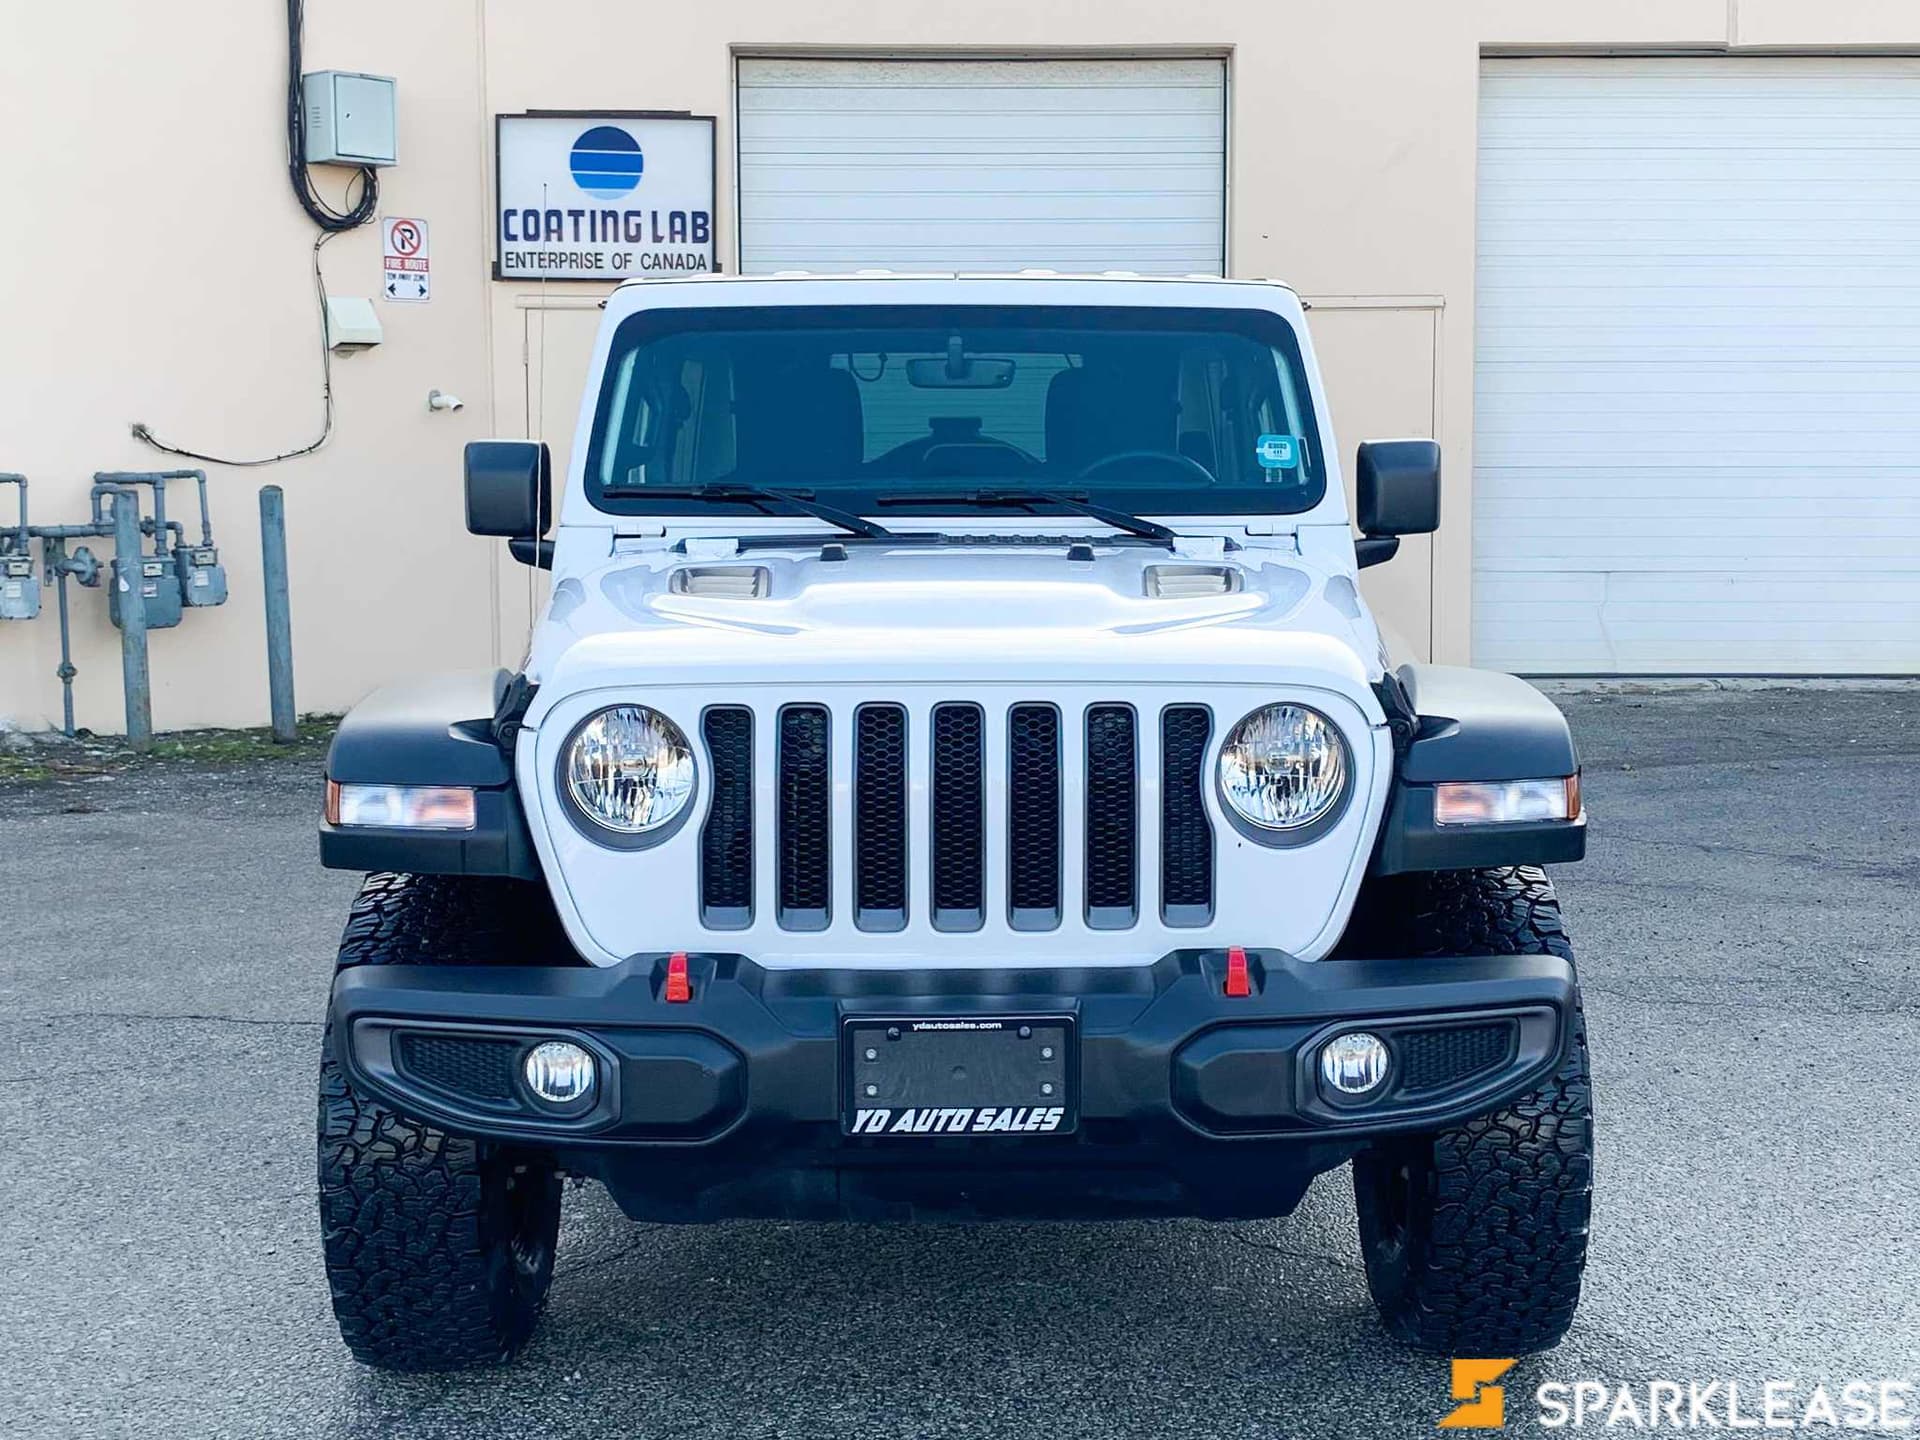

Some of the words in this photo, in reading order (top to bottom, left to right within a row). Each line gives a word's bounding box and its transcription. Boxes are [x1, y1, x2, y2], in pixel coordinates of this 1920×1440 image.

[503, 208, 642, 243] COATING
[652, 210, 710, 243] LAB
[505, 251, 604, 269] ENTERPRISE
[612, 252, 633, 270] OF
[641, 252, 708, 270] CANADA
[912, 1021, 1003, 1031] ydautosales.com
[851, 1109, 891, 1133] YD
[889, 1108, 974, 1132] AUTO
[972, 1107, 1064, 1131] SALES
